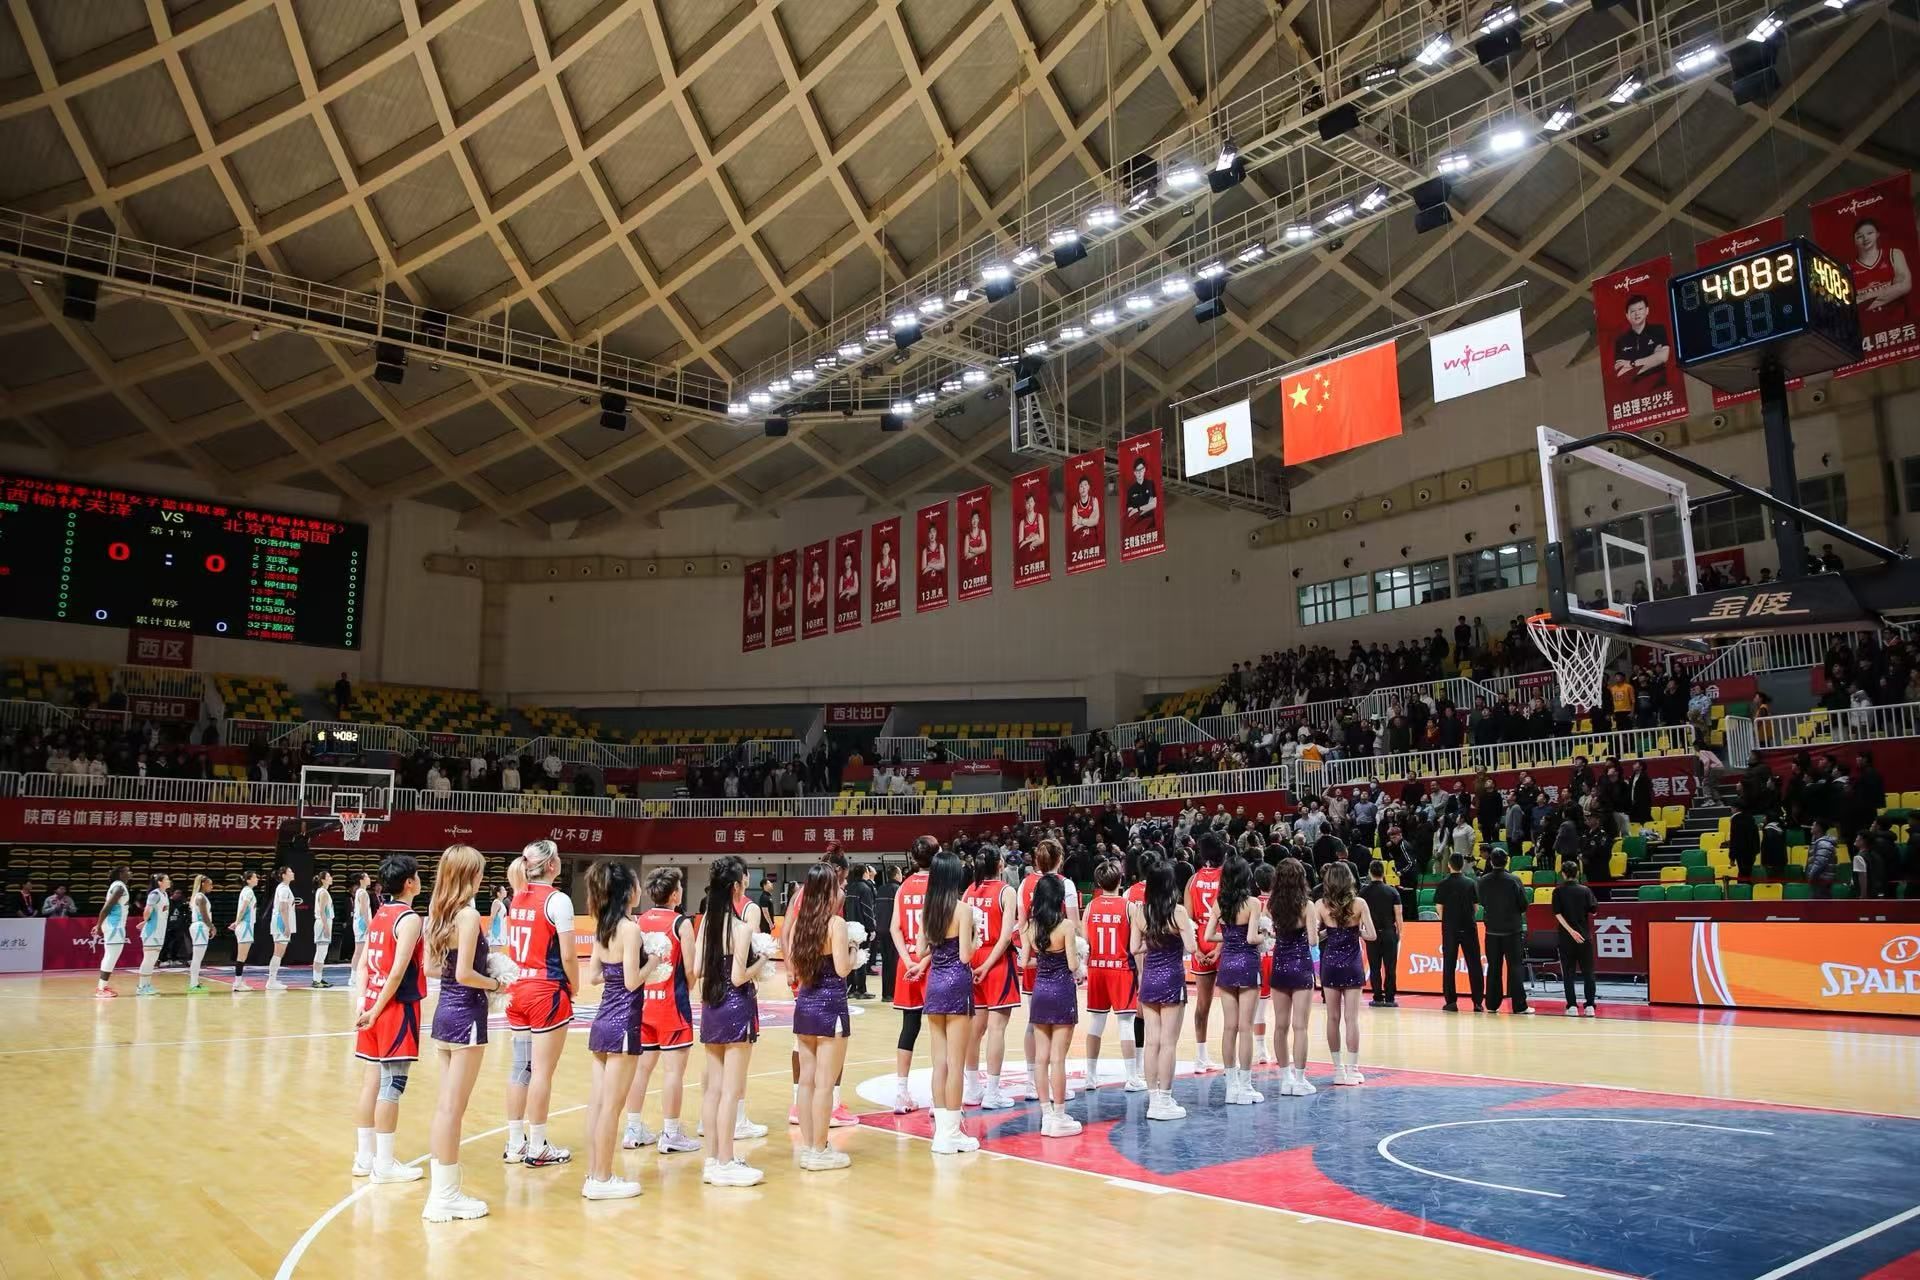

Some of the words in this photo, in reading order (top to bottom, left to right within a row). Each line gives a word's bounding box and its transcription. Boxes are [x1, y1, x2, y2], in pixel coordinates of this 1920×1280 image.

[1838, 195, 1884, 214] WCBA
[1720, 237, 1761, 254] WCBA
[1614, 274, 1650, 290] WCBA
[1443, 343, 1511, 371] WCBA
[161, 510, 184, 524] VS
[108, 542, 130, 561] 0
[205, 554, 227, 573] 0
[96, 609, 107, 620] 0
[1691, 591, 1810, 621] 金陵
[216, 622, 227, 632] 0
[138, 637, 185, 661] 西区
[833, 706, 886, 721] 西北出口
[715, 829, 784, 843] 团结一心
[804, 828, 875, 842] 顽强拼搏
[1201, 892, 1214, 918] 5
[510, 925, 532, 963] 47
[1097, 927, 1118, 955] 11
[1593, 916, 1633, 958] 奋
